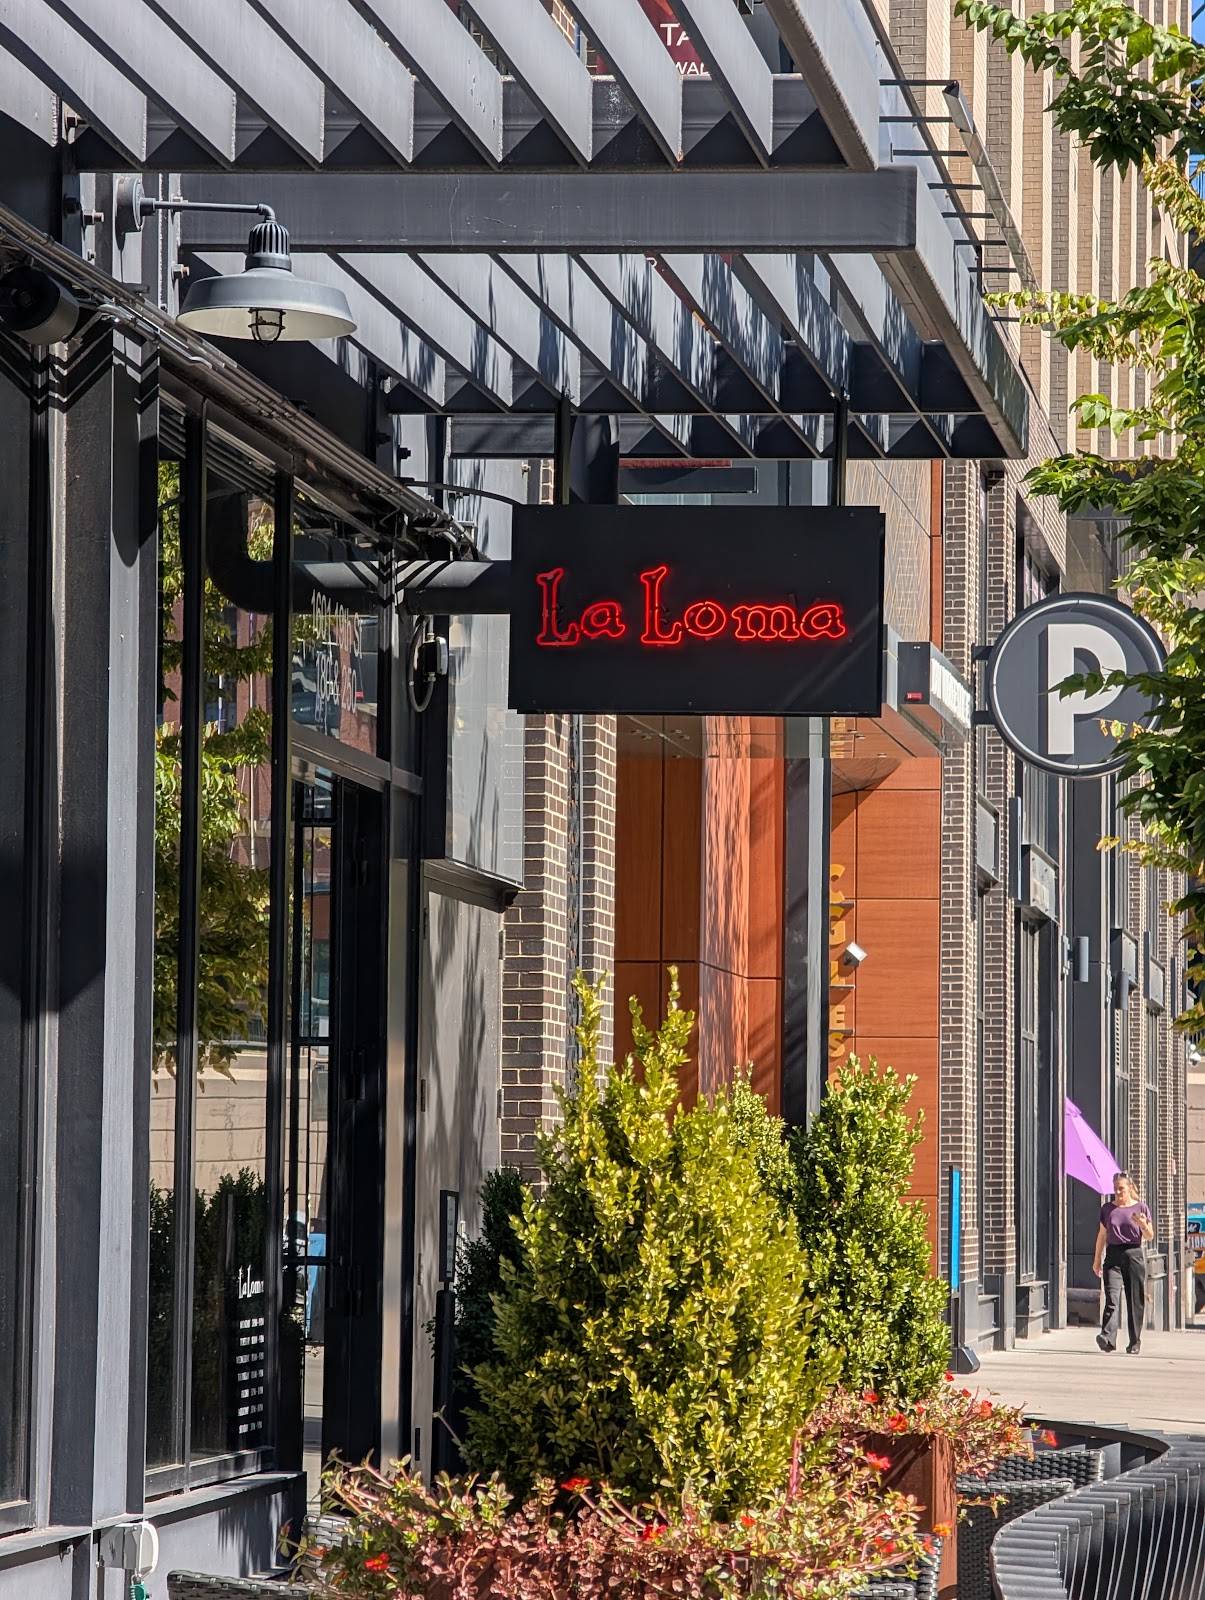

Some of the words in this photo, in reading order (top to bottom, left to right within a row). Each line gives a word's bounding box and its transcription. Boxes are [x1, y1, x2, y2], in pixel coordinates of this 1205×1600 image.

[536, 568, 626, 645] La
[641, 566, 846, 645] Loma
[1047, 623, 1127, 755] P
